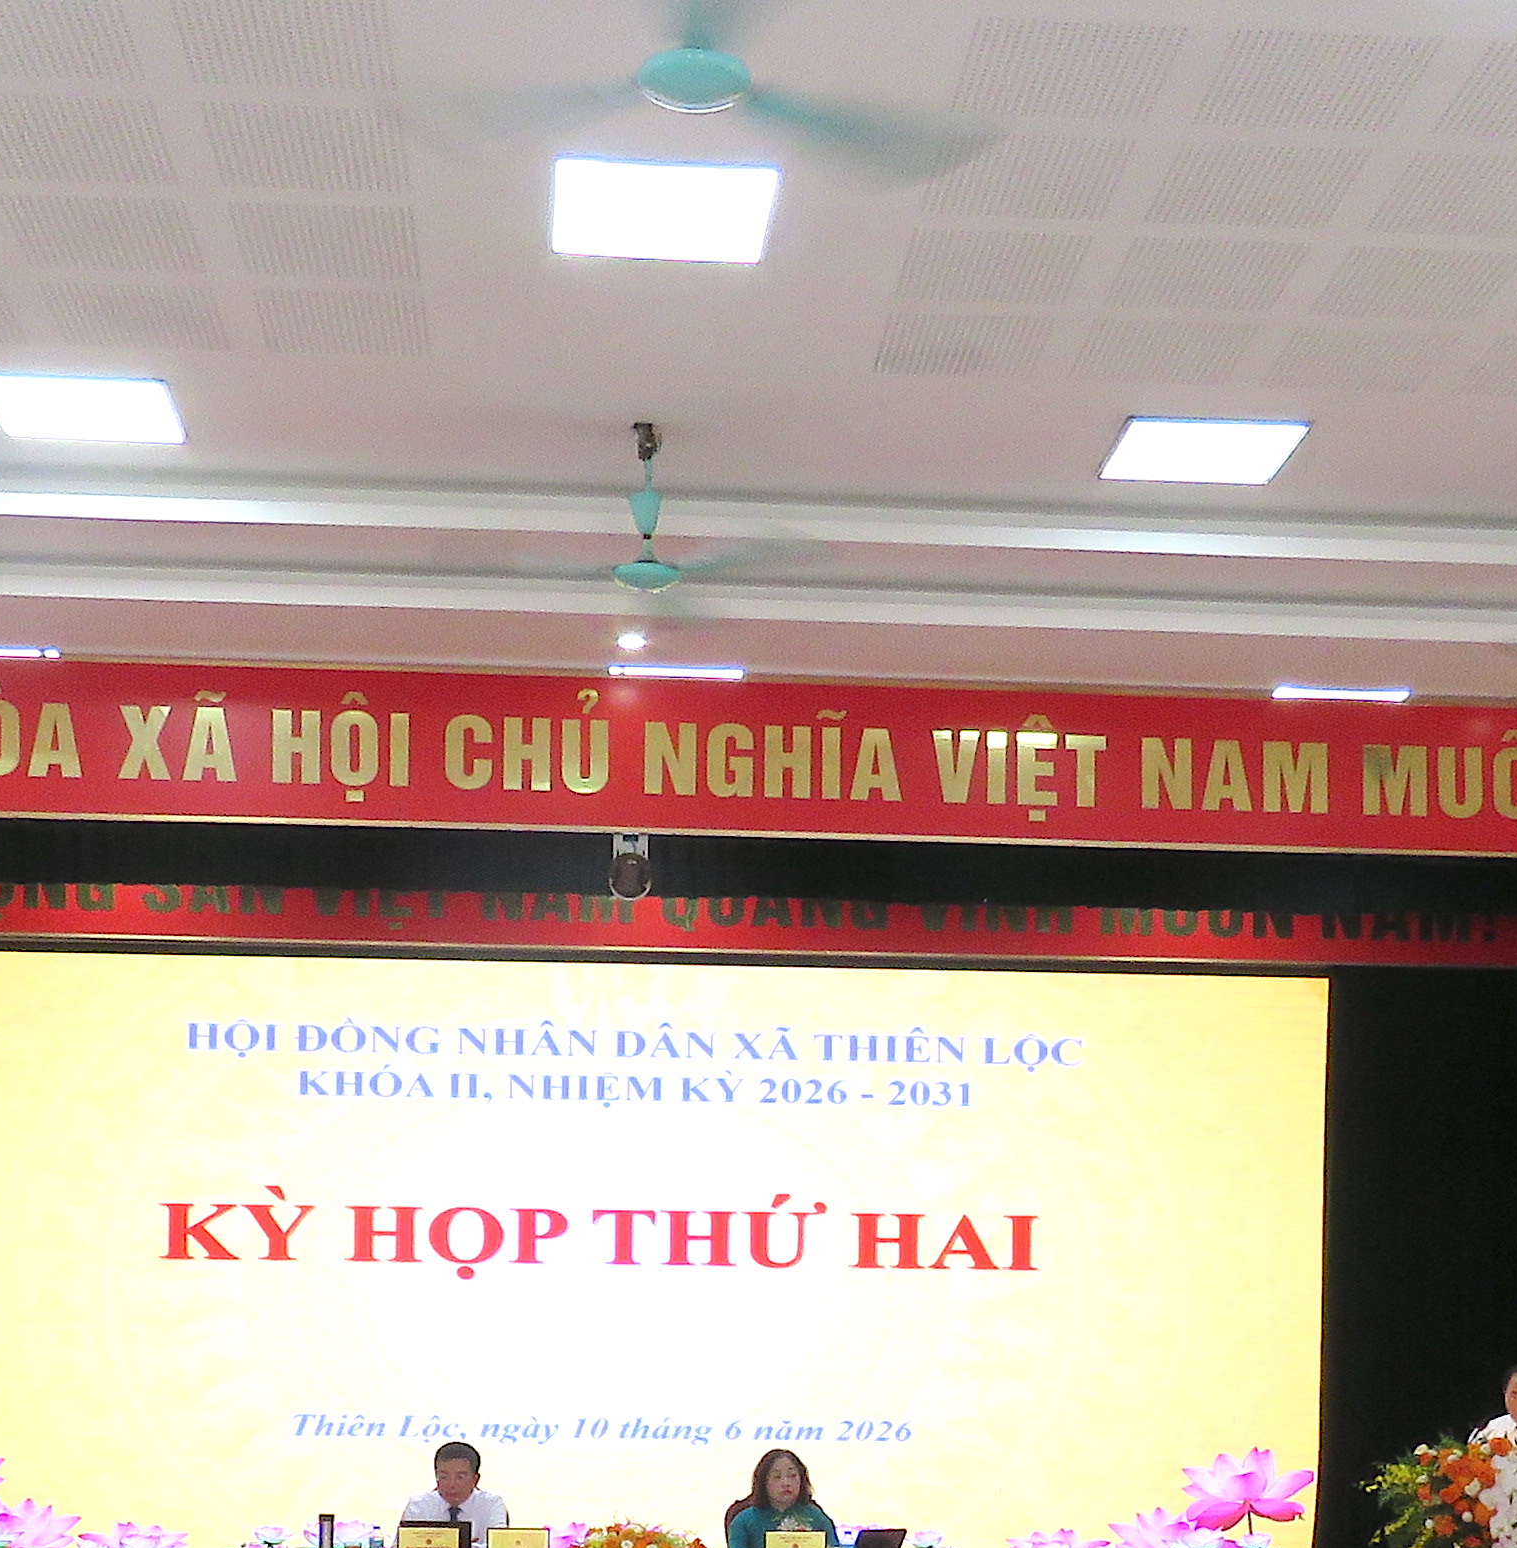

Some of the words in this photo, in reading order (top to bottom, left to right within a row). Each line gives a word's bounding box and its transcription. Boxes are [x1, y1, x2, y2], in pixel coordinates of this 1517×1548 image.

[118, 690, 238, 783] XÃ
[271, 691, 411, 802] HỘI
[444, 688, 610, 795] CHỦ
[643, 709, 903, 802] NGHĨA
[932, 713, 1108, 822] VIỆT
[1141, 737, 1330, 815] NAM
[186, 1019, 278, 1058] HỘI
[294, 1017, 440, 1054] ĐỒNG
[458, 1020, 597, 1057] NHÂN
[615, 1022, 716, 1059] DÂN
[734, 1027, 798, 1061] XÃ
[814, 1027, 966, 1063] THIÊN
[983, 1033, 1083, 1072] LỘC
[298, 1064, 434, 1097] KHÓA
[449, 1073, 493, 1102] II,
[509, 1072, 663, 1108] NHIỆM
[682, 1070, 745, 1103] KỲ
[759, 1078, 848, 1105] 2026
[888, 1080, 971, 1107] 2031
[158, 1184, 315, 1261] KỲ
[345, 1206, 569, 1280] HỌP
[593, 1193, 829, 1269] THỨ
[848, 1211, 1041, 1272] HAI
[293, 1413, 386, 1437] Thiên
[397, 1414, 467, 1443] Lộc,
[480, 1415, 559, 1445] ngày
[573, 1417, 610, 1439] 10
[619, 1417, 713, 1446] tháng
[725, 1419, 743, 1441] 6
[753, 1420, 824, 1441] năm
[836, 1420, 913, 1442] 2026
